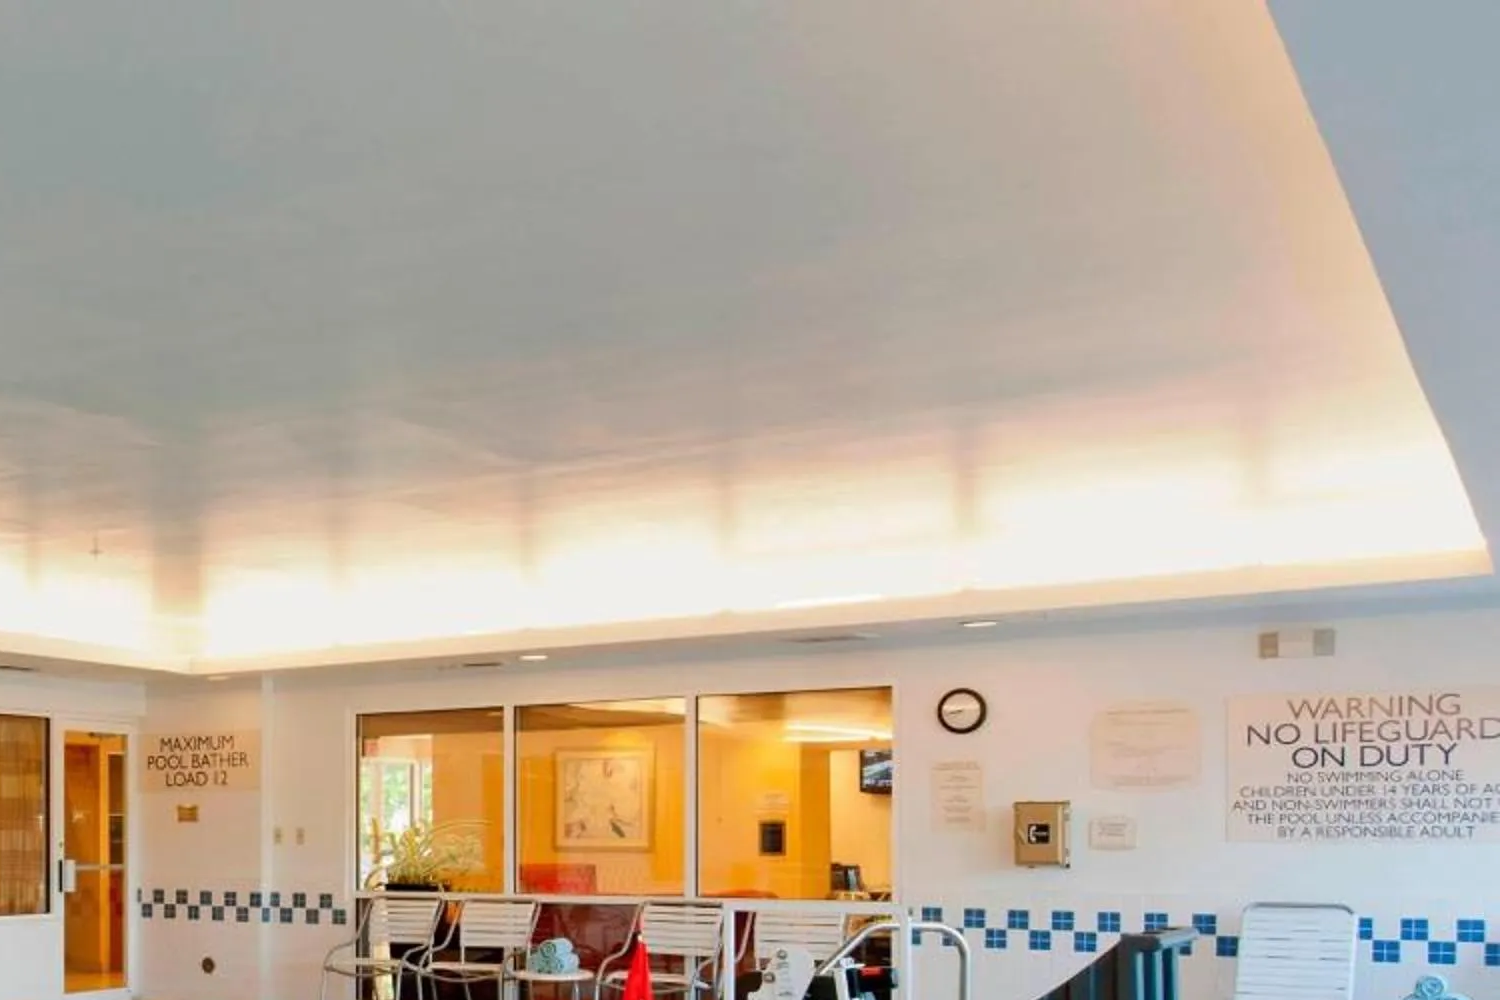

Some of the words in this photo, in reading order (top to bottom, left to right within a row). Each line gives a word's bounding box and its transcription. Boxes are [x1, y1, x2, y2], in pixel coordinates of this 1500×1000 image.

[1287, 693, 1461, 719] WARNING
[1247, 722, 1301, 745] NO
[1314, 717, 1500, 744] LIFEGUARD
[160, 735, 235, 752] MAXIMUM
[147, 755, 188, 771] POOL
[191, 752, 249, 769] BATHER
[1291, 746, 1345, 769] ON
[1360, 743, 1457, 767] DUTY
[165, 771, 208, 787] LOAD
[213, 769, 228, 786] 12
[1286, 771, 1313, 784] NO
[1317, 770, 1402, 783] SWIMMING
[1406, 769, 1465, 782] ALONE
[1240, 785, 1317, 798] CHILDREN
[1321, 785, 1376, 797] UNDER
[1382, 784, 1397, 796] 14
[1402, 783, 1450, 796] YEARS
[1455, 783, 1478, 795] OF
[1233, 799, 1267, 811] AND
[1401, 798, 1448, 810] SHALL
[1454, 797, 1492, 809] NOT
[1248, 813, 1273, 825] THE
[1279, 813, 1321, 825] POOL
[1326, 812, 1382, 824] UNLESS
[1278, 826, 1295, 838] BY
[1301, 827, 1311, 838] A
[1316, 825, 1415, 838] RESPONSIBLE
[1419, 825, 1475, 838] ADULT
